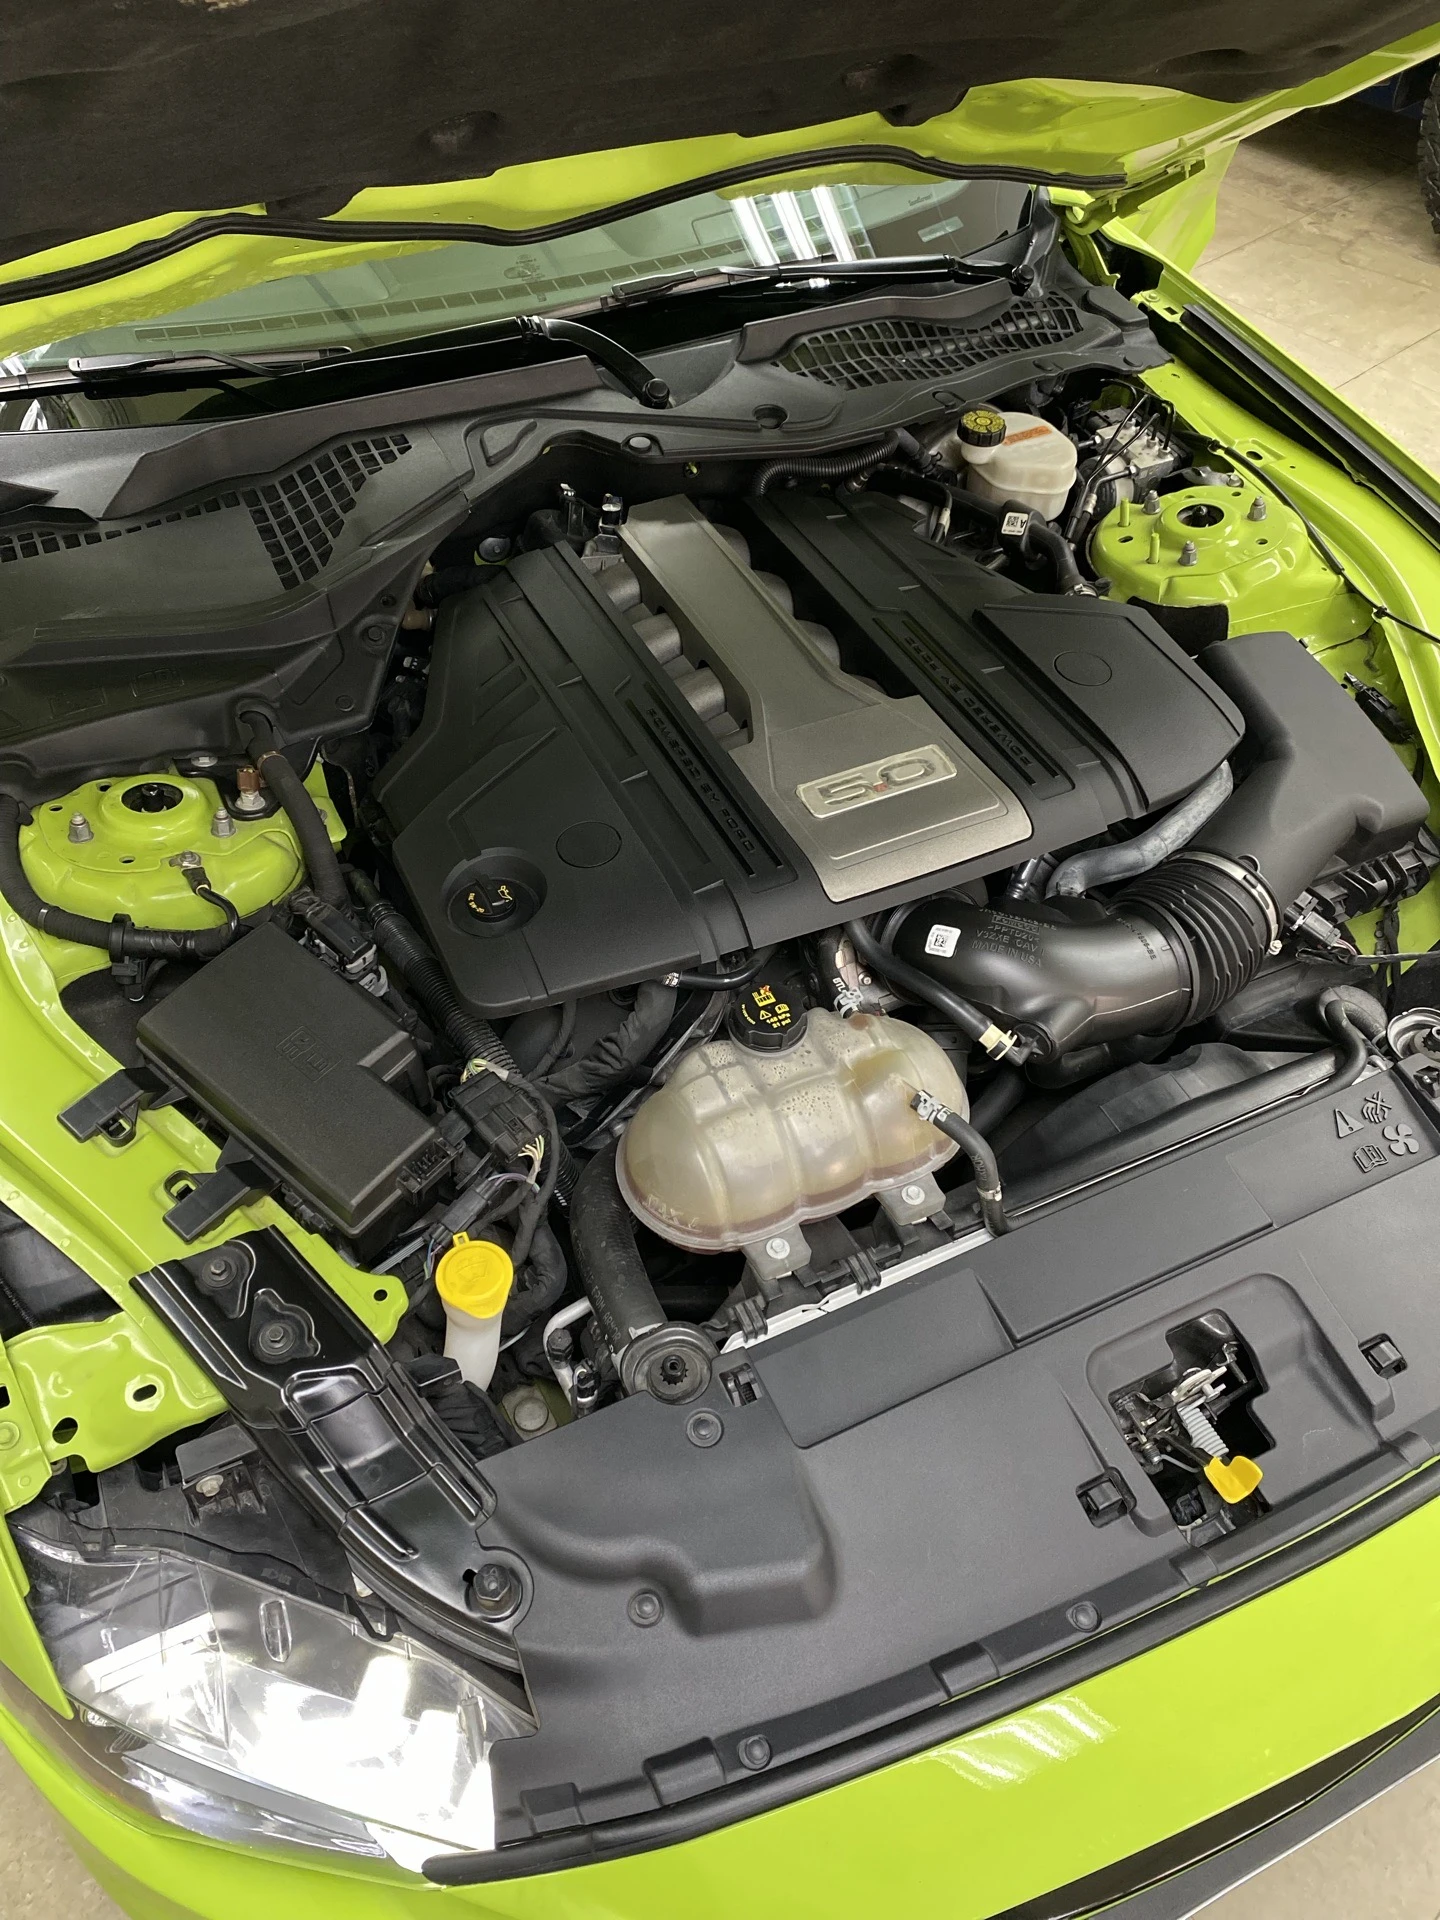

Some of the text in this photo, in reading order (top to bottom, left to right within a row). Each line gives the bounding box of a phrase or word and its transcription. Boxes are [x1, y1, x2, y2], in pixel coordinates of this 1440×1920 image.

[904, 636, 1033, 766] POWERED BY FORD
[815, 758, 936, 806] 5.0
[721, 808, 755, 853] FORD
[971, 940, 1041, 968] MADE IN USA
[1015, 939, 1039, 952] CAV
